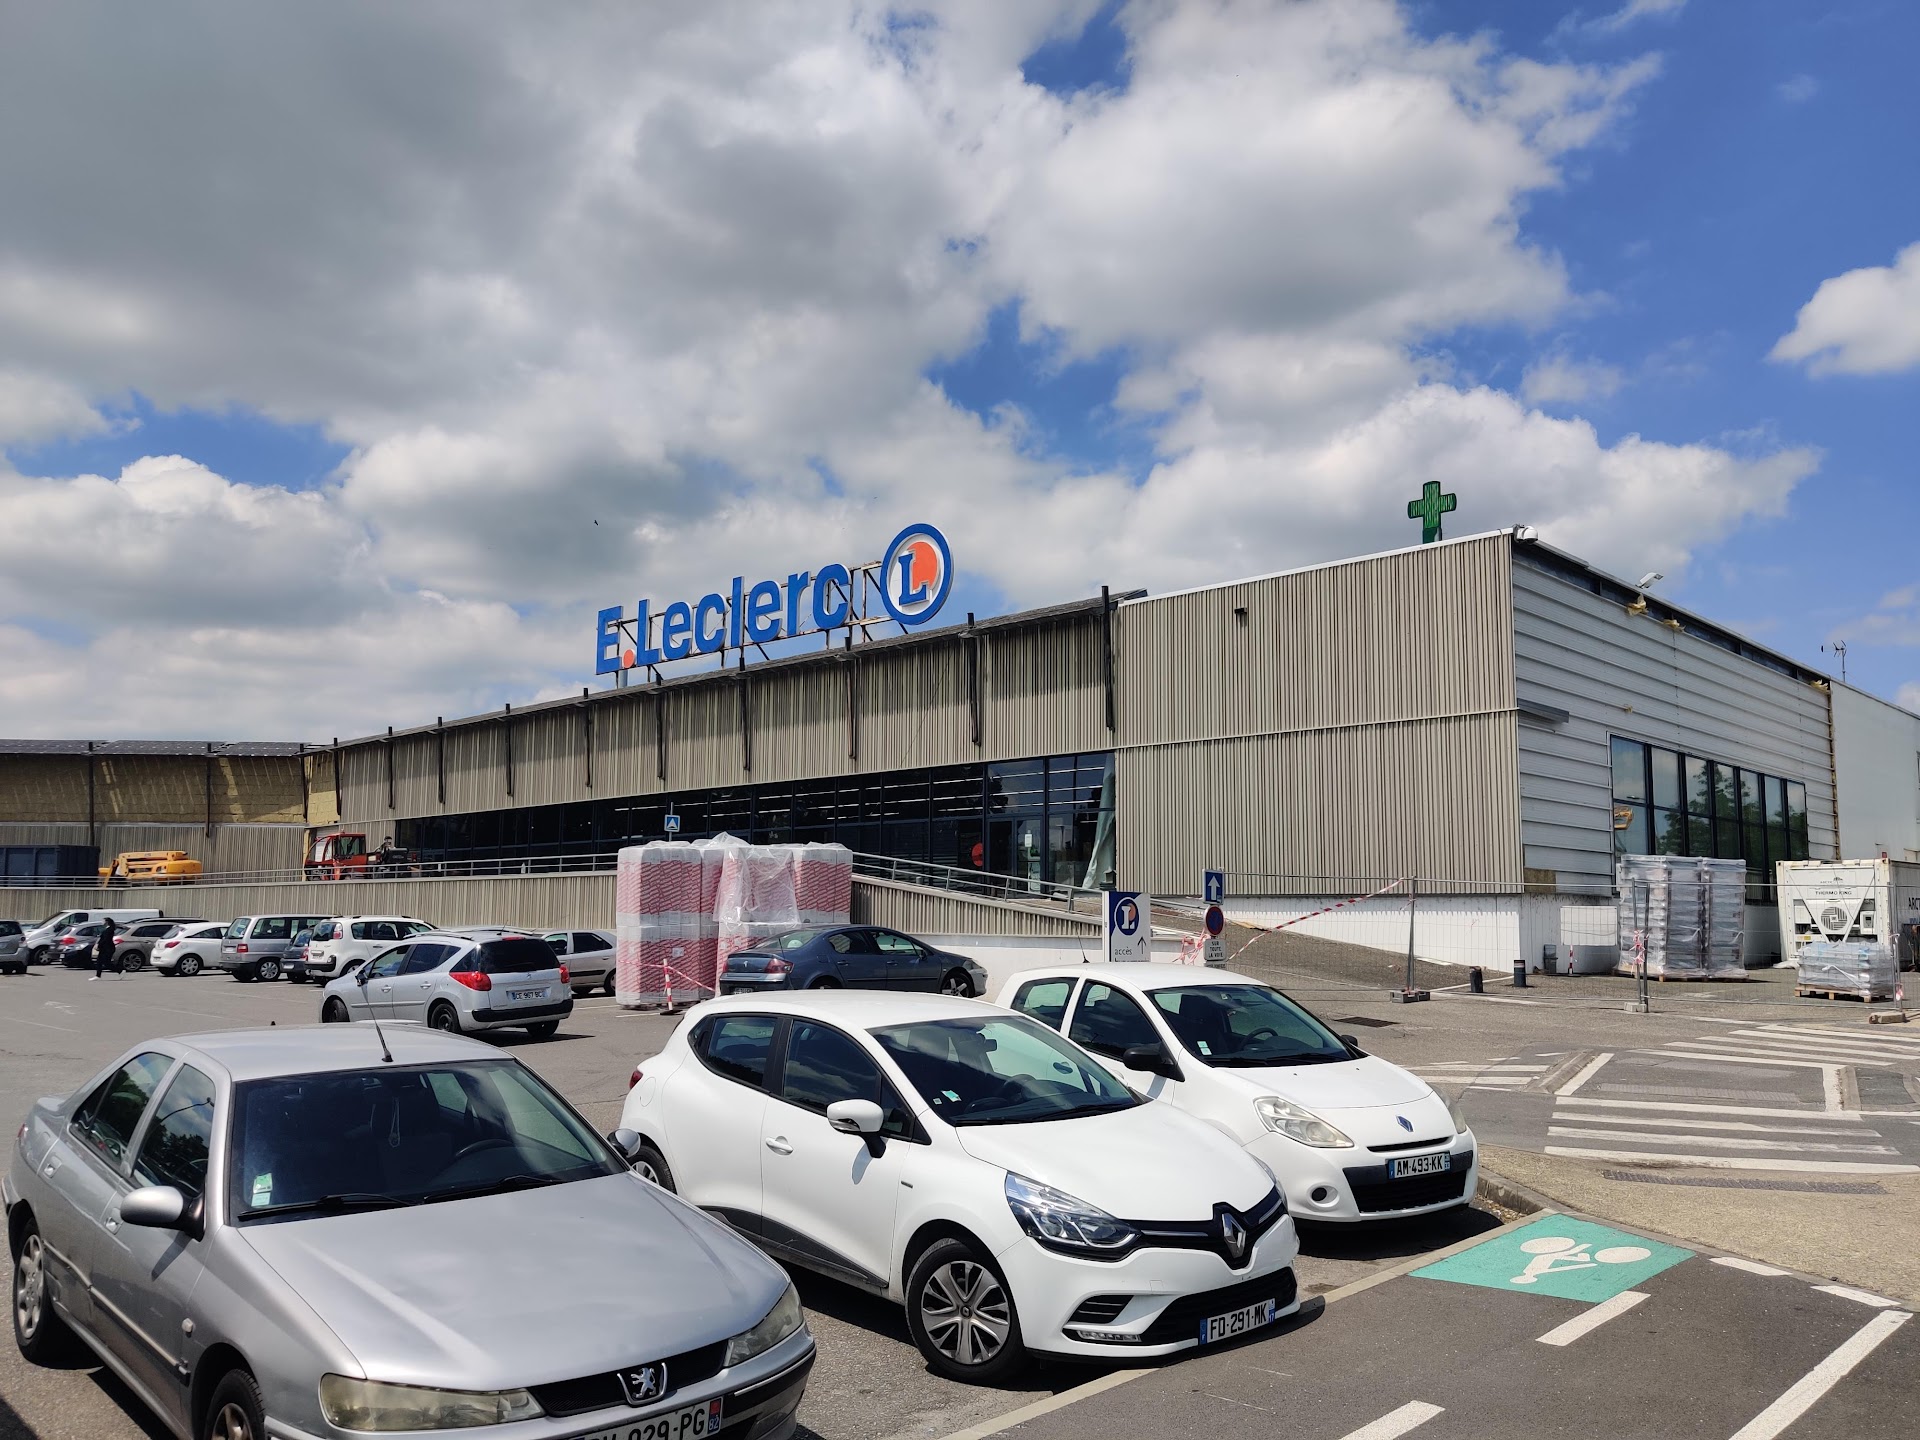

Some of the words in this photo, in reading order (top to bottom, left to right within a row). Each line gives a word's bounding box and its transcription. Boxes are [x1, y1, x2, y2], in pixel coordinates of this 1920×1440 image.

[596, 563, 852, 675] E.Leclerc
[1114, 947, 1133, 956] accès
[1396, 1155, 1443, 1176] AM-493-KK
[1210, 1302, 1267, 1340] FD-291-MK
[708, 1415, 720, 1431] 82
